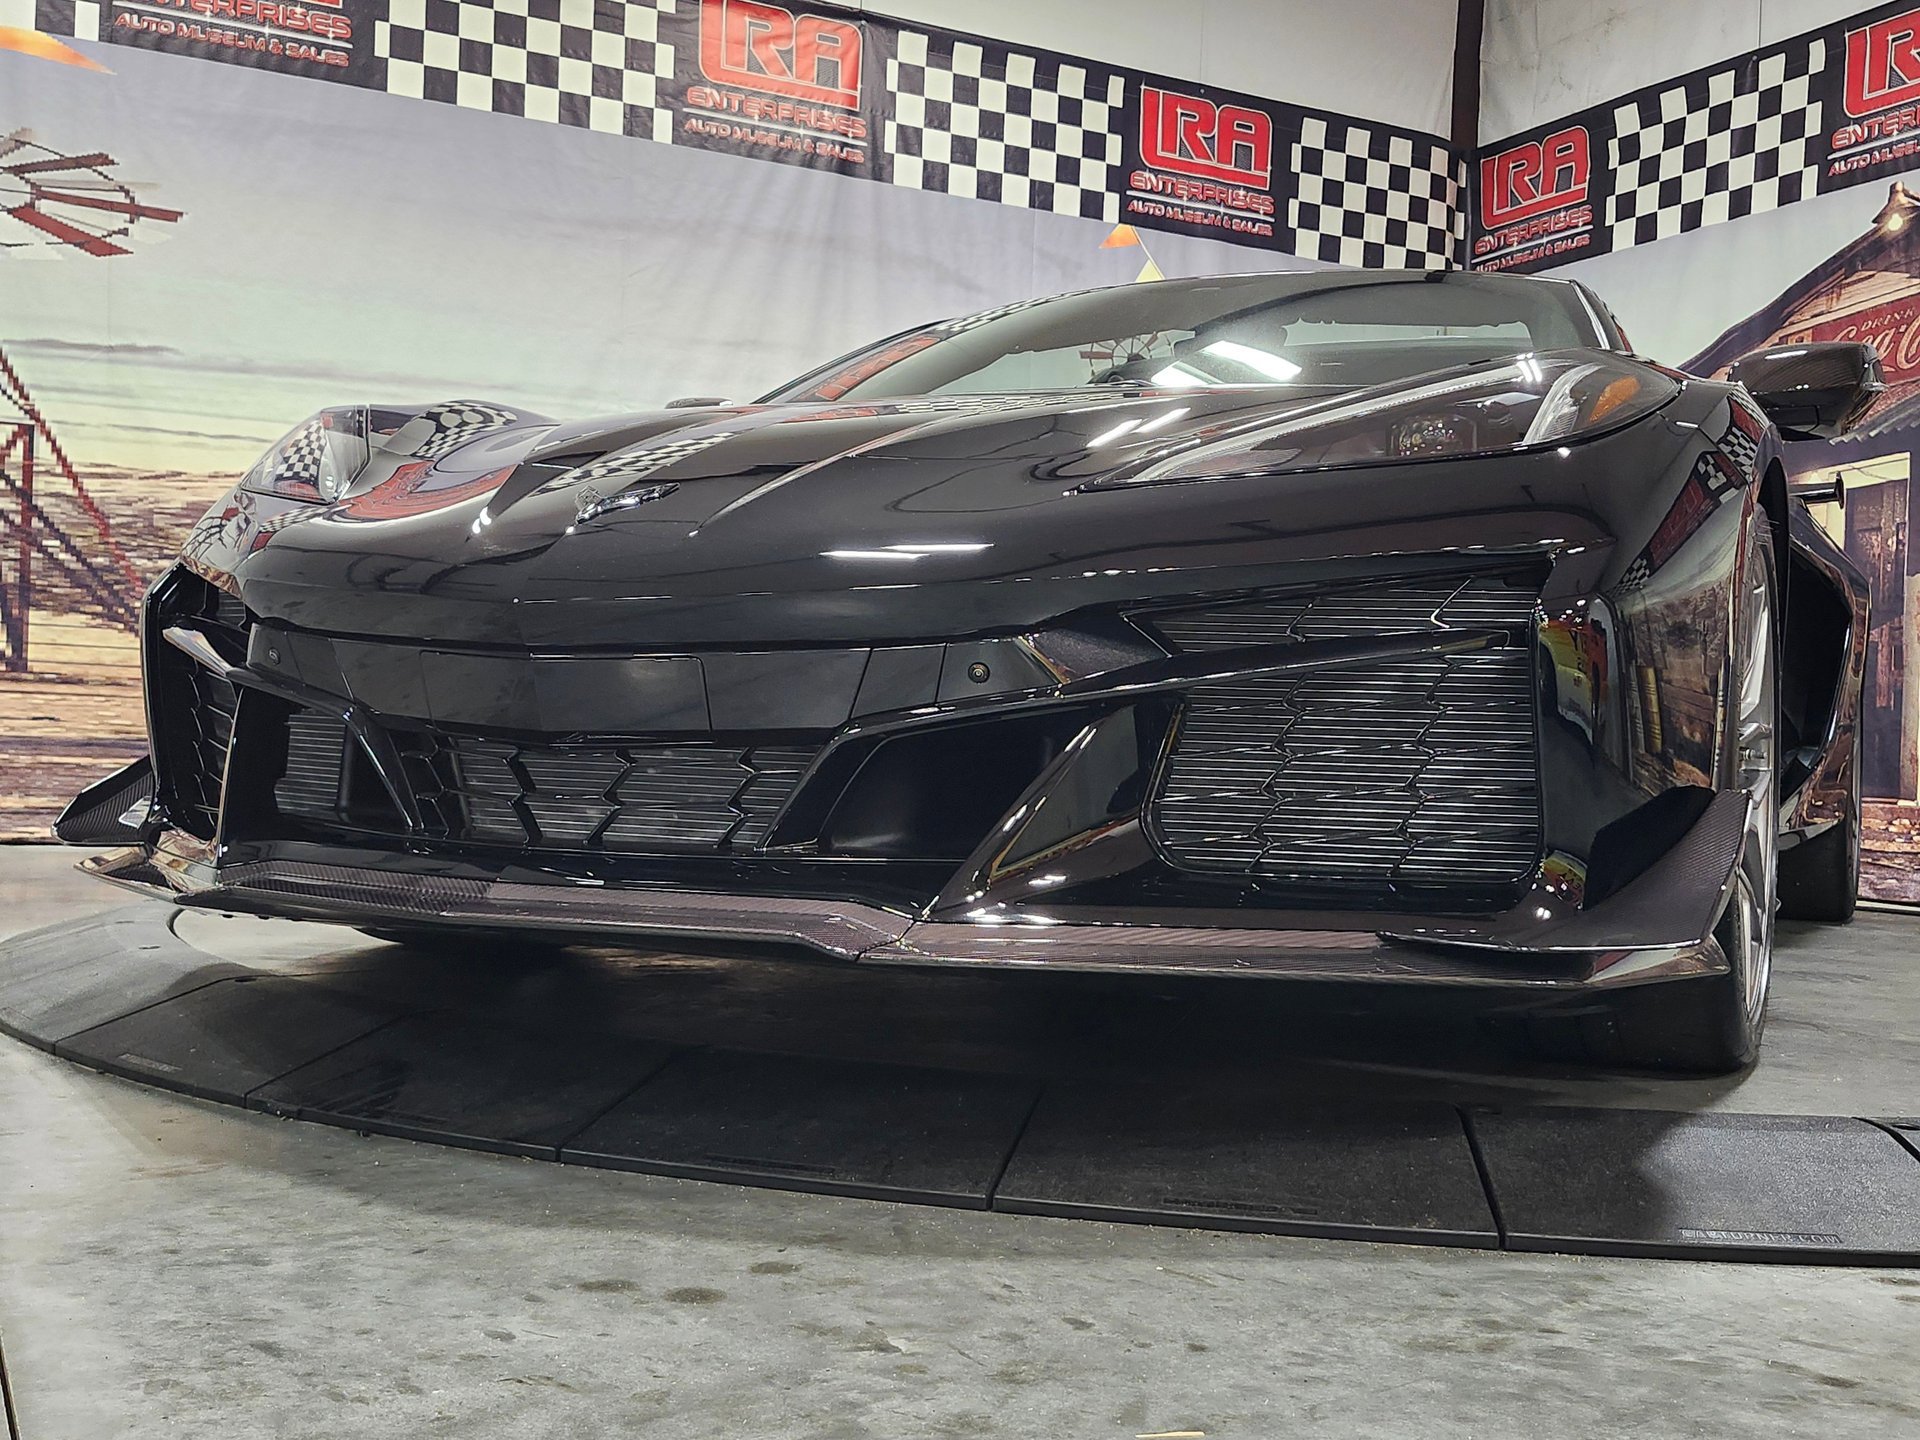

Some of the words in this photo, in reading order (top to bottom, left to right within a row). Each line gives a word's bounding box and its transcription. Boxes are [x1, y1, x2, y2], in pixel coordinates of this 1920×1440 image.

[114, 12, 175, 36] AUTO
[177, 22, 266, 51] MUSEUM
[268, 38, 284, 56] &
[286, 43, 349, 68] SALES
[155, 0, 352, 39] ERPRISES
[699, 0, 863, 111] LRA
[1843, 7, 1920, 119] LR
[686, 85, 867, 138] ENTERPRISES
[1831, 104, 1920, 149] ENTER
[684, 118, 731, 138] AUTO
[732, 126, 802, 150] MUSEUM
[803, 139, 815, 154] &
[816, 142, 865, 164] SALES
[1139, 85, 1273, 191] LRA
[1480, 125, 1591, 230] LRA
[1828, 153, 1870, 177] AUTO
[1129, 170, 1275, 215] ENTERPRISES
[1127, 200, 1165, 217] AUTO
[1166, 206, 1222, 227] MUSEUM
[1222, 216, 1232, 229] &
[1232, 219, 1273, 236] SALES
[1474, 204, 1593, 255] ENTERPRISES
[1500, 245, 1545, 269] MUSEUM
[1545, 243, 1554, 256] &
[1554, 234, 1591, 254] SALES
